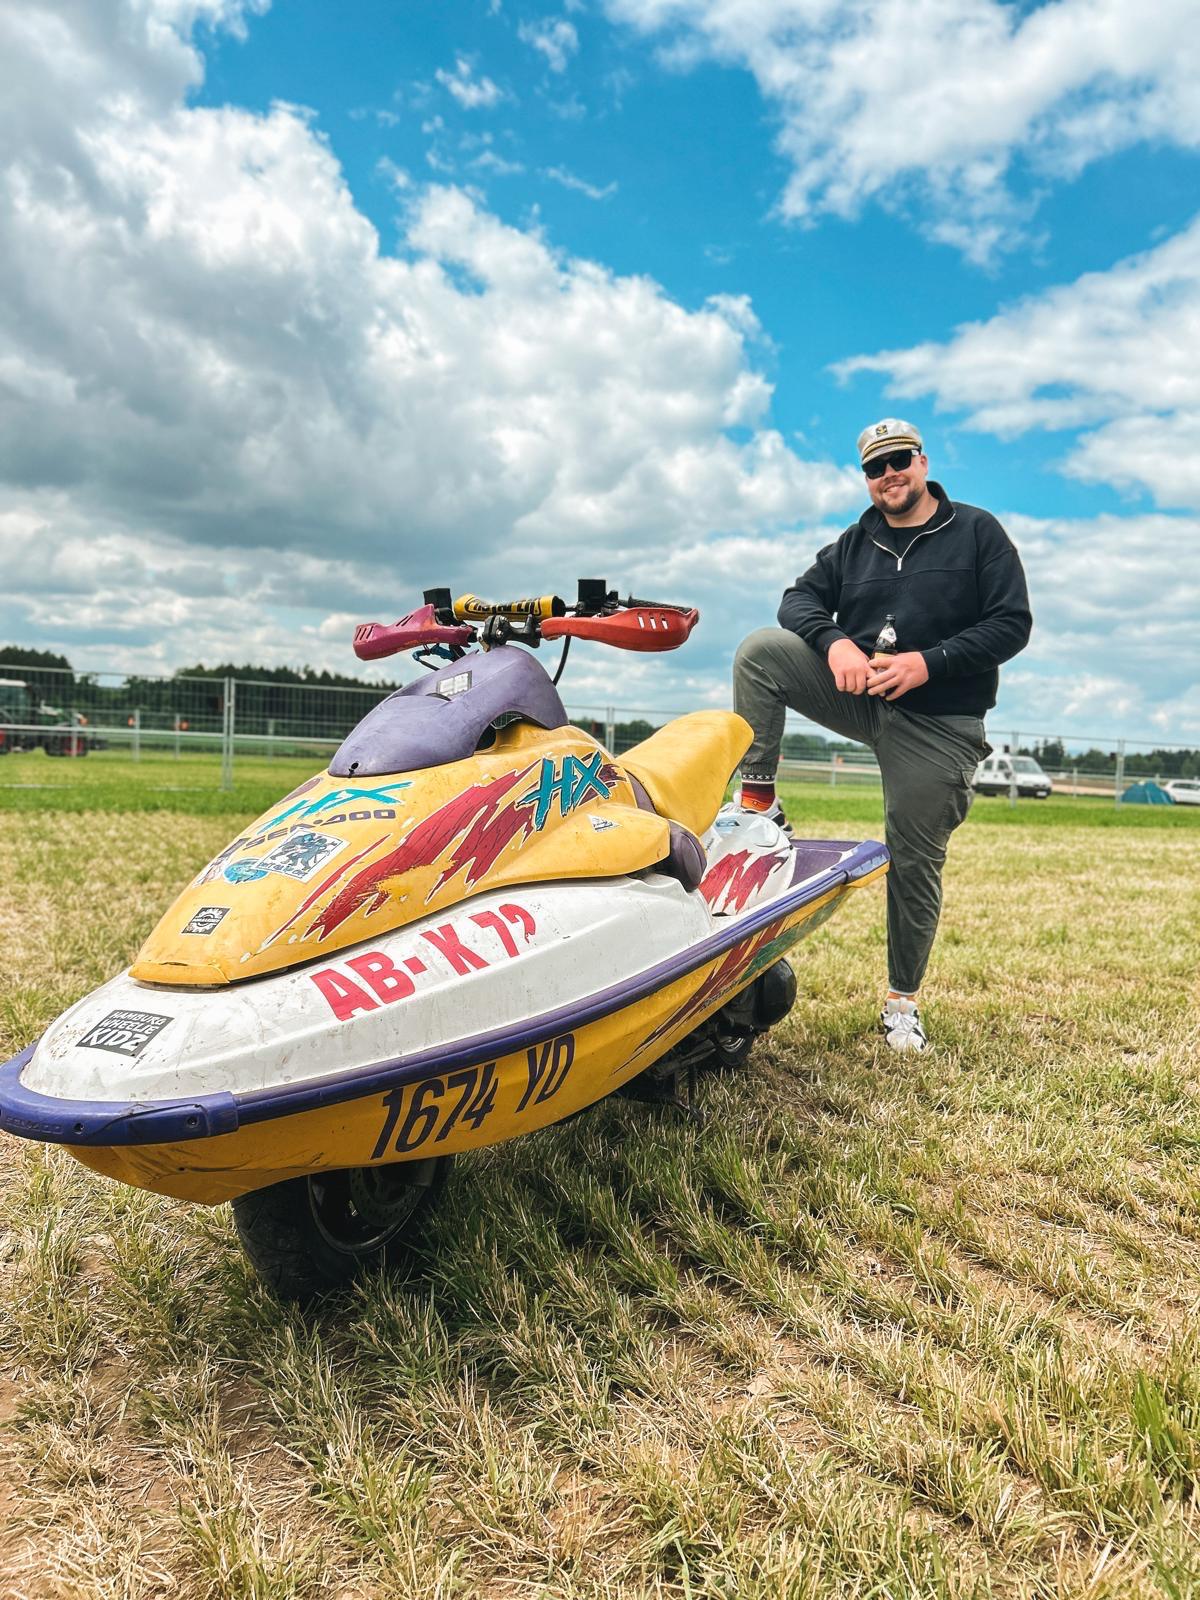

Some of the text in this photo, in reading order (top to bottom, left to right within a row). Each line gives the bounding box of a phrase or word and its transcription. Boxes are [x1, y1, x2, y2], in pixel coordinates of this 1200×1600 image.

[514, 750, 611, 832] HX
[98, 1019, 160, 1035] WHEELIE
[108, 1011, 167, 1026] HAMBURG
[81, 1027, 149, 1052] KIDZ
[370, 1033, 576, 1161] 1674 YD
